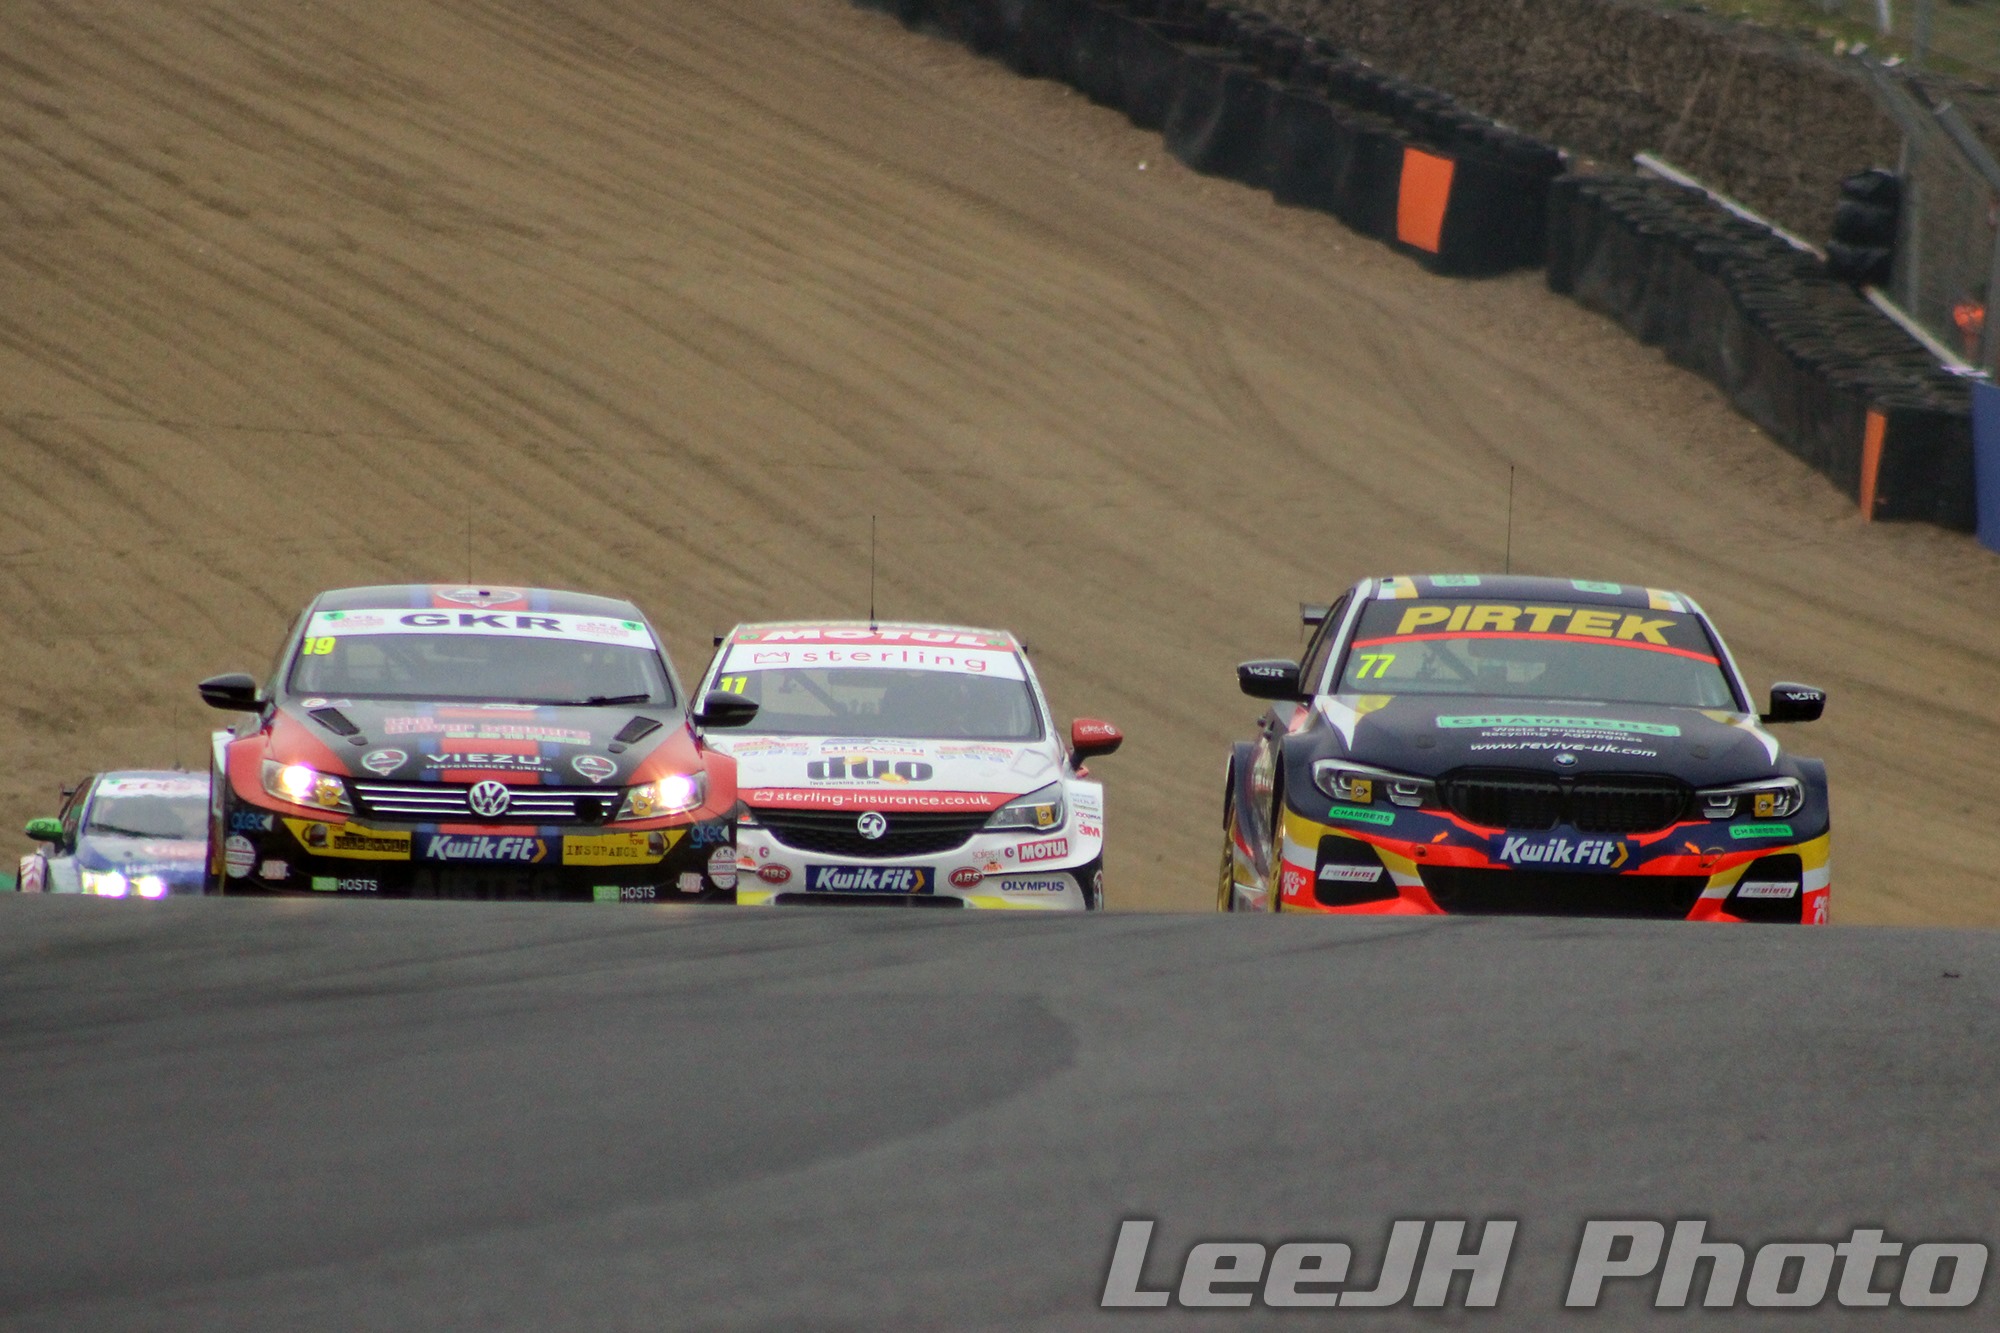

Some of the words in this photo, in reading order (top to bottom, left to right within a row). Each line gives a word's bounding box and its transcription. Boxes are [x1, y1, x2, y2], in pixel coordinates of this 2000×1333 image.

[400, 613, 564, 632] GKR
[1396, 605, 1677, 646] PIRTEK
[303, 637, 336, 655] 19
[761, 630, 987, 647] MOTUL
[803, 650, 986, 672] sterling
[1356, 654, 1396, 679] 77
[720, 676, 747, 695] 11
[1470, 741, 1657, 757] www.revive-uk.com
[427, 754, 541, 765] VIEZU
[807, 756, 933, 781] duo
[777, 792, 991, 806] sterling-insurance.co.uk
[1333, 808, 1391, 823] CHAMBERS
[1079, 824, 1100, 838] 3M
[1020, 840, 1067, 860] MOTUL
[762, 868, 787, 879] ABS
[954, 873, 980, 883] ABS
[338, 879, 378, 891] HOSTS
[621, 886, 656, 899] HOSTS
[1001, 881, 1065, 892] OLYMPUS
